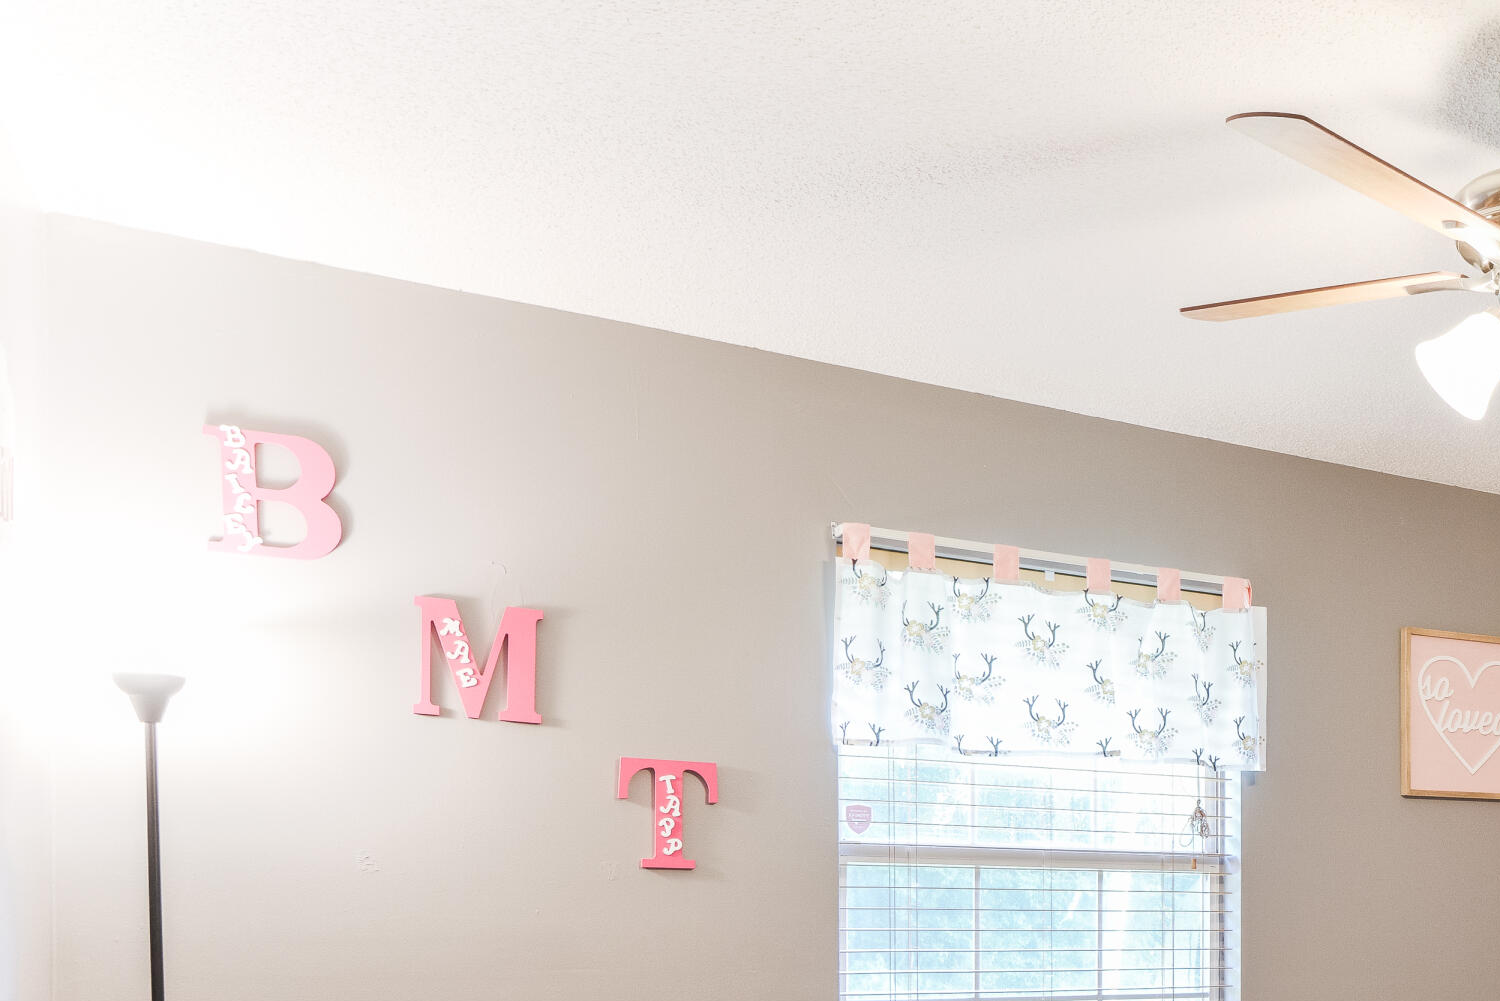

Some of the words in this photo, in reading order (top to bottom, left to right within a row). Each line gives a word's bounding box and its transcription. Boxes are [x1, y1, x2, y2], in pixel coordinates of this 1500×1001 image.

[202, 423, 344, 560] B
[412, 594, 545, 725] M
[439, 616, 478, 690] MAE
[1421, 674, 1454, 702] so
[617, 756, 719, 870] T
[658, 774, 683, 856] TAPP
